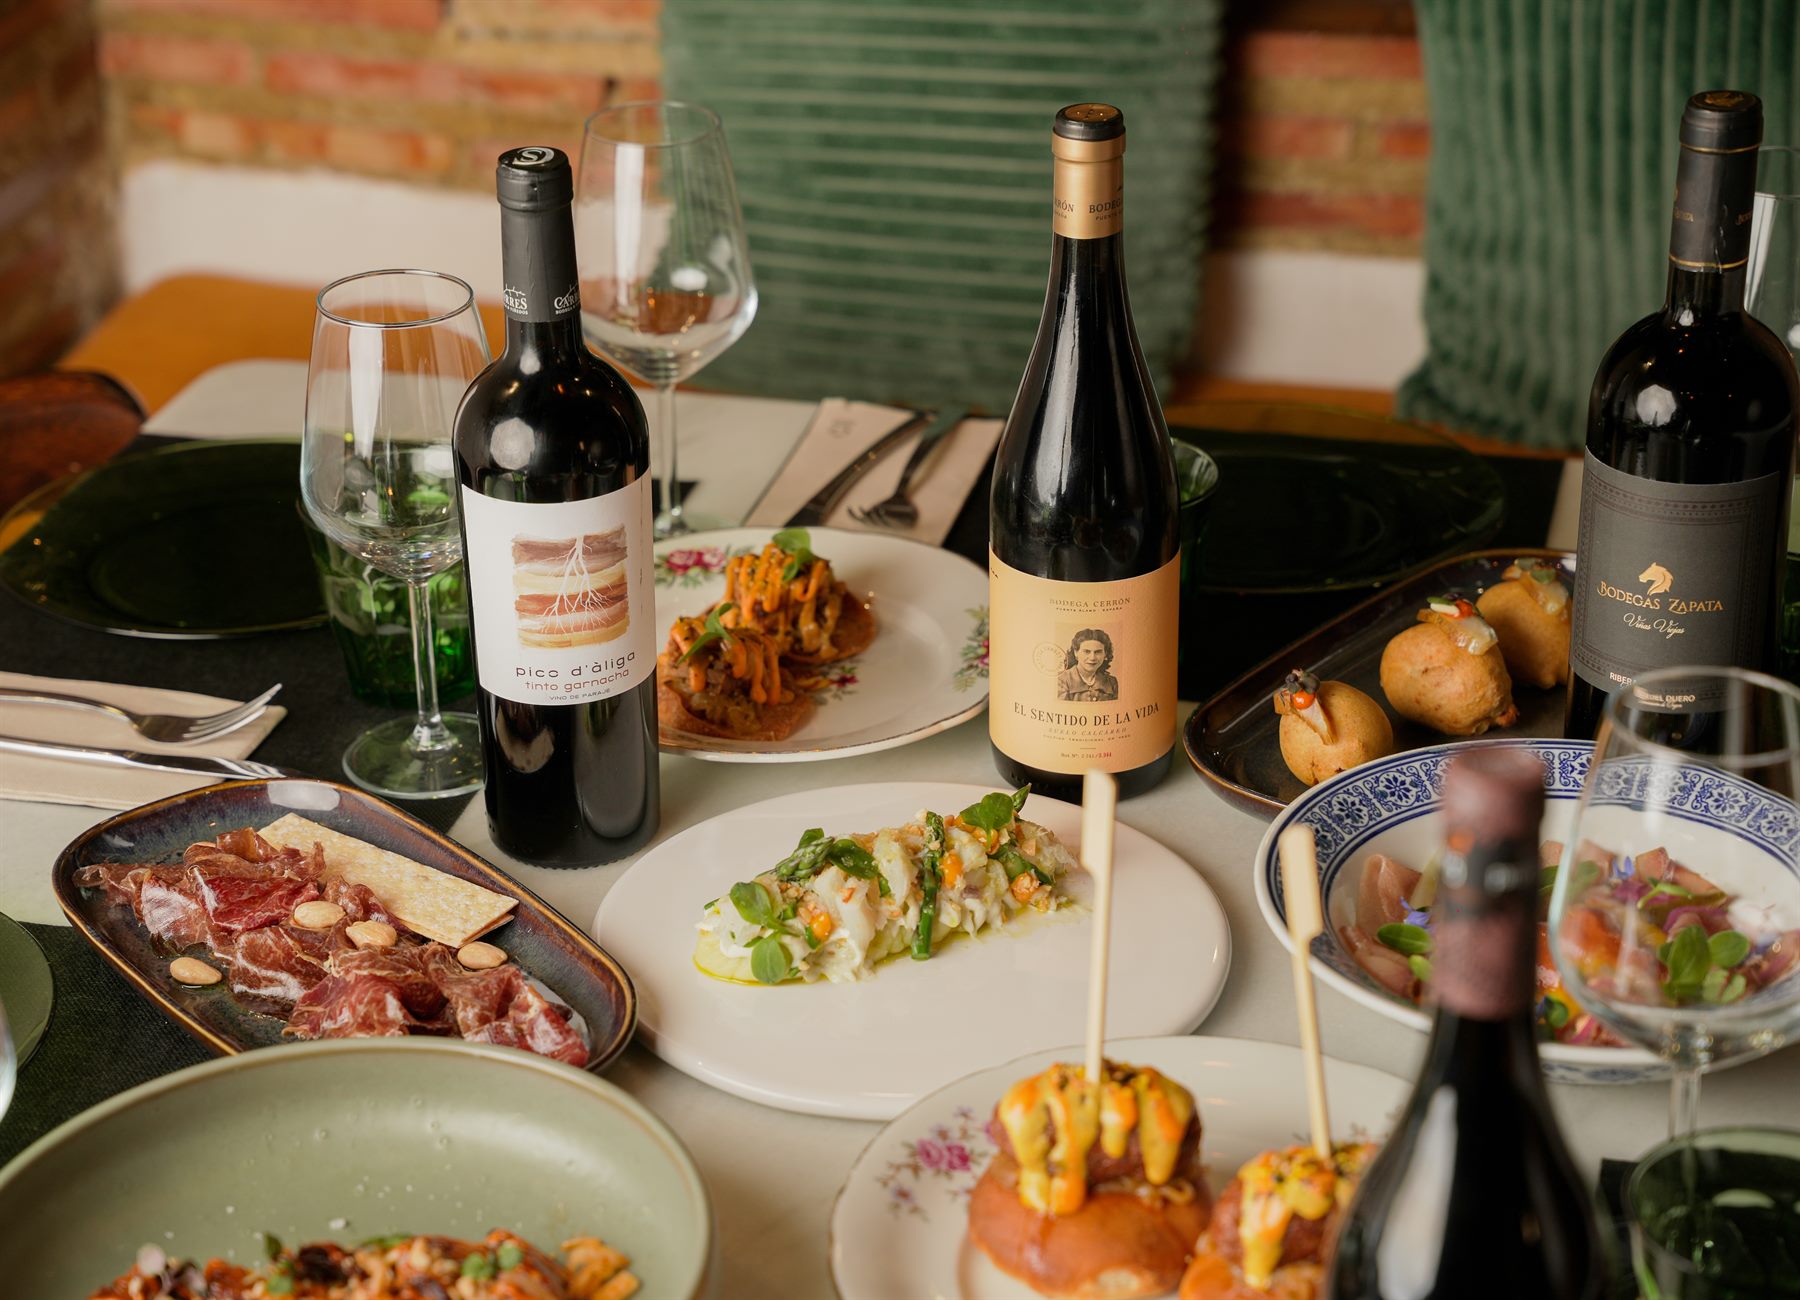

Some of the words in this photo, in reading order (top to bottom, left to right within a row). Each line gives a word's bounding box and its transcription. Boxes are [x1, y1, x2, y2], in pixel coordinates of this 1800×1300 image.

[1667, 598, 1724, 615] ZAPATA
[516, 666, 560, 678] pico
[525, 681, 559, 691] tinto
[563, 669, 630, 693] garnacha
[581, 688, 611, 698] PARAJE
[1014, 701, 1026, 716] EL
[1030, 707, 1088, 727] SENTIDO
[1094, 715, 1110, 727] DE
[1116, 713, 1131, 725] LA
[1135, 701, 1159, 720] VIDA
